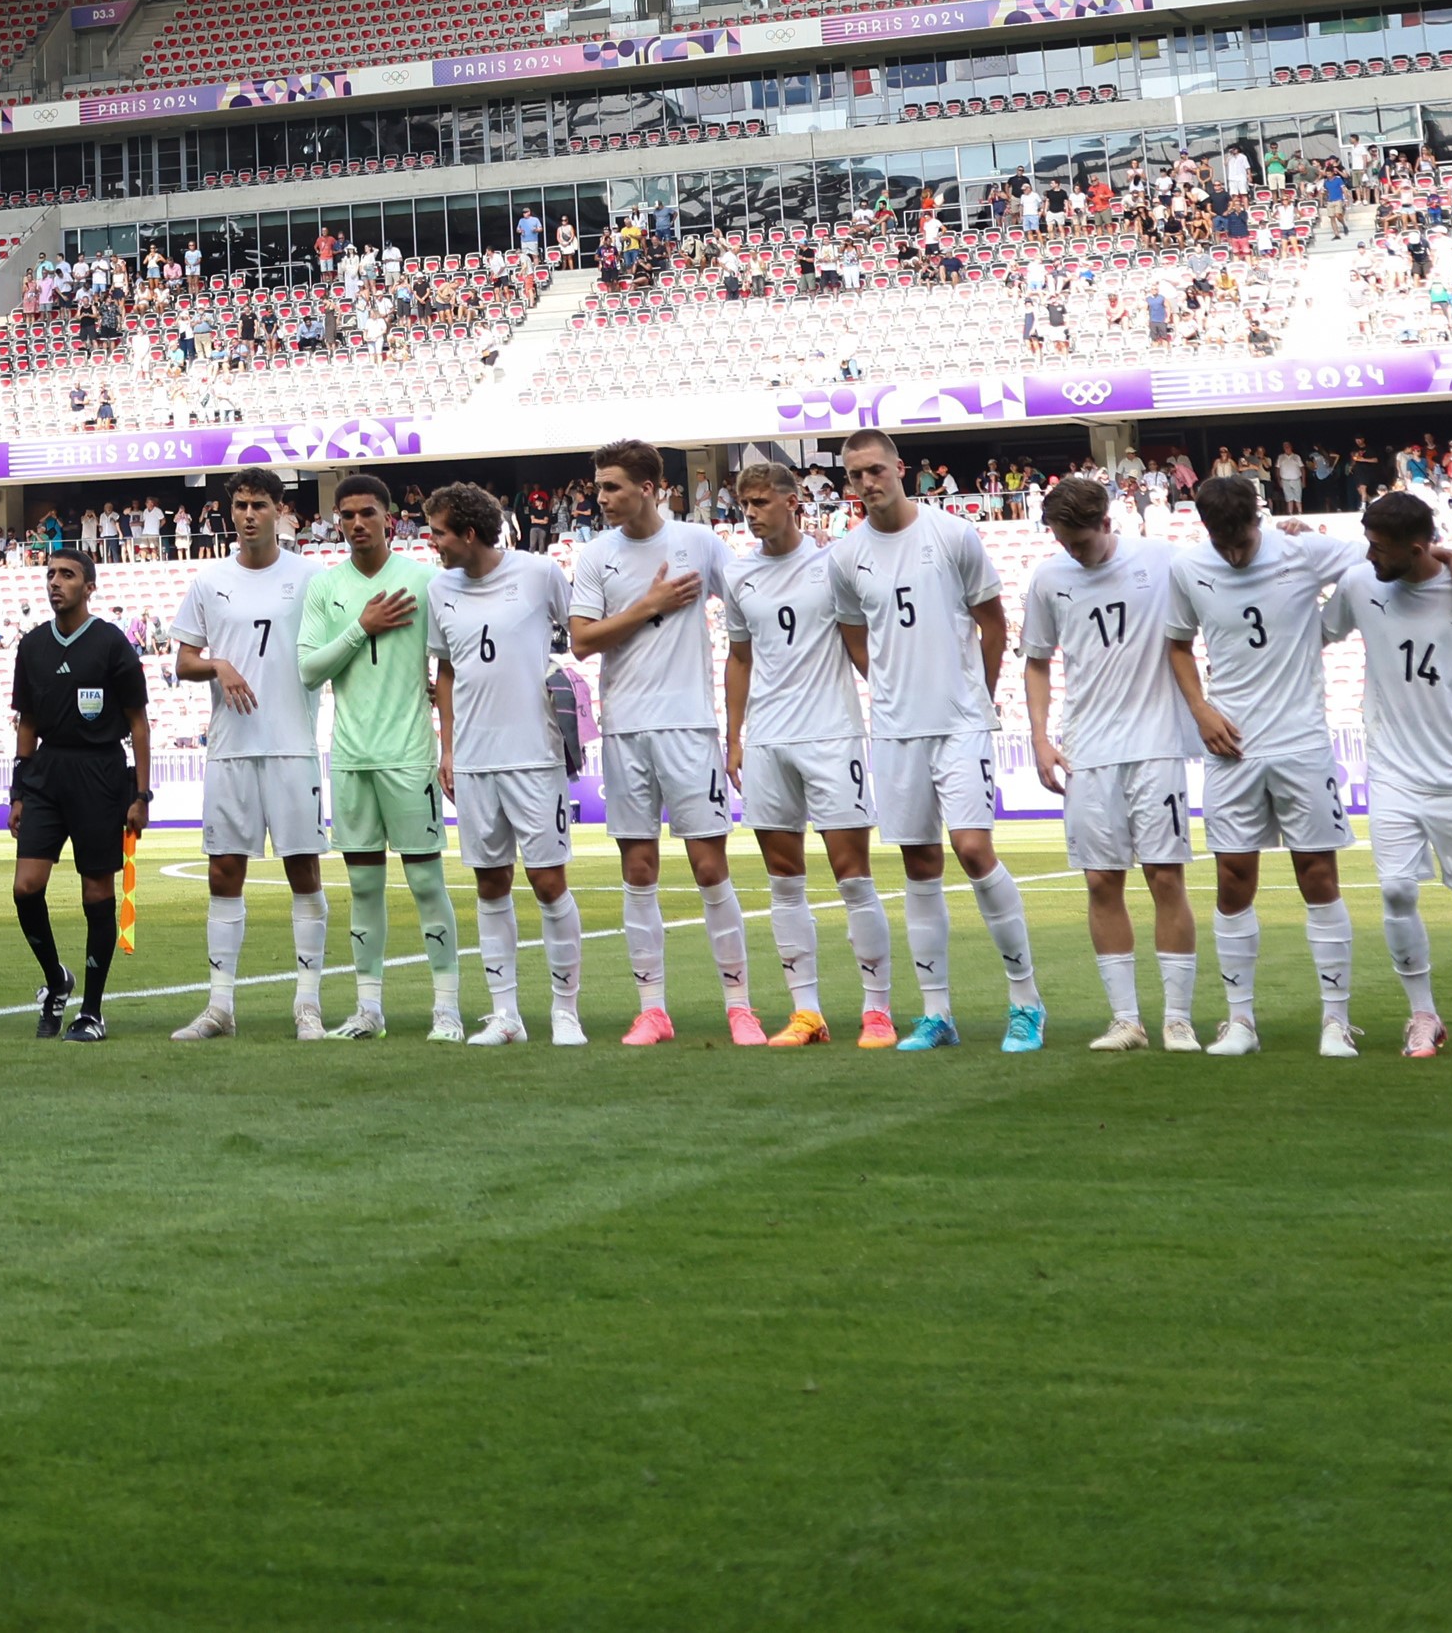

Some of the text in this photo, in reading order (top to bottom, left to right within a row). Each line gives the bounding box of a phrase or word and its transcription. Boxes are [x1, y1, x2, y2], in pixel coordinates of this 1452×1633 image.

[92, 7, 115, 22] D3.3
[910, 10, 965, 28] 2024
[514, 54, 562, 71] 2024
[153, 94, 198, 110] 2024
[1296, 364, 1385, 390] 2024
[126, 439, 194, 461] 2024
[778, 607, 796, 645] 9
[895, 587, 916, 627] 5
[1089, 602, 1127, 648] 17
[254, 619, 271, 657] 7
[479, 624, 496, 663] 6
[1244, 607, 1267, 648] 3
[369, 634, 377, 666] 1
[1398, 640, 1439, 686] 14
[708, 769, 725, 806] 4
[850, 759, 864, 800] 9
[424, 784, 436, 821] 1
[555, 793, 566, 834] 6
[1325, 777, 1344, 821] 3
